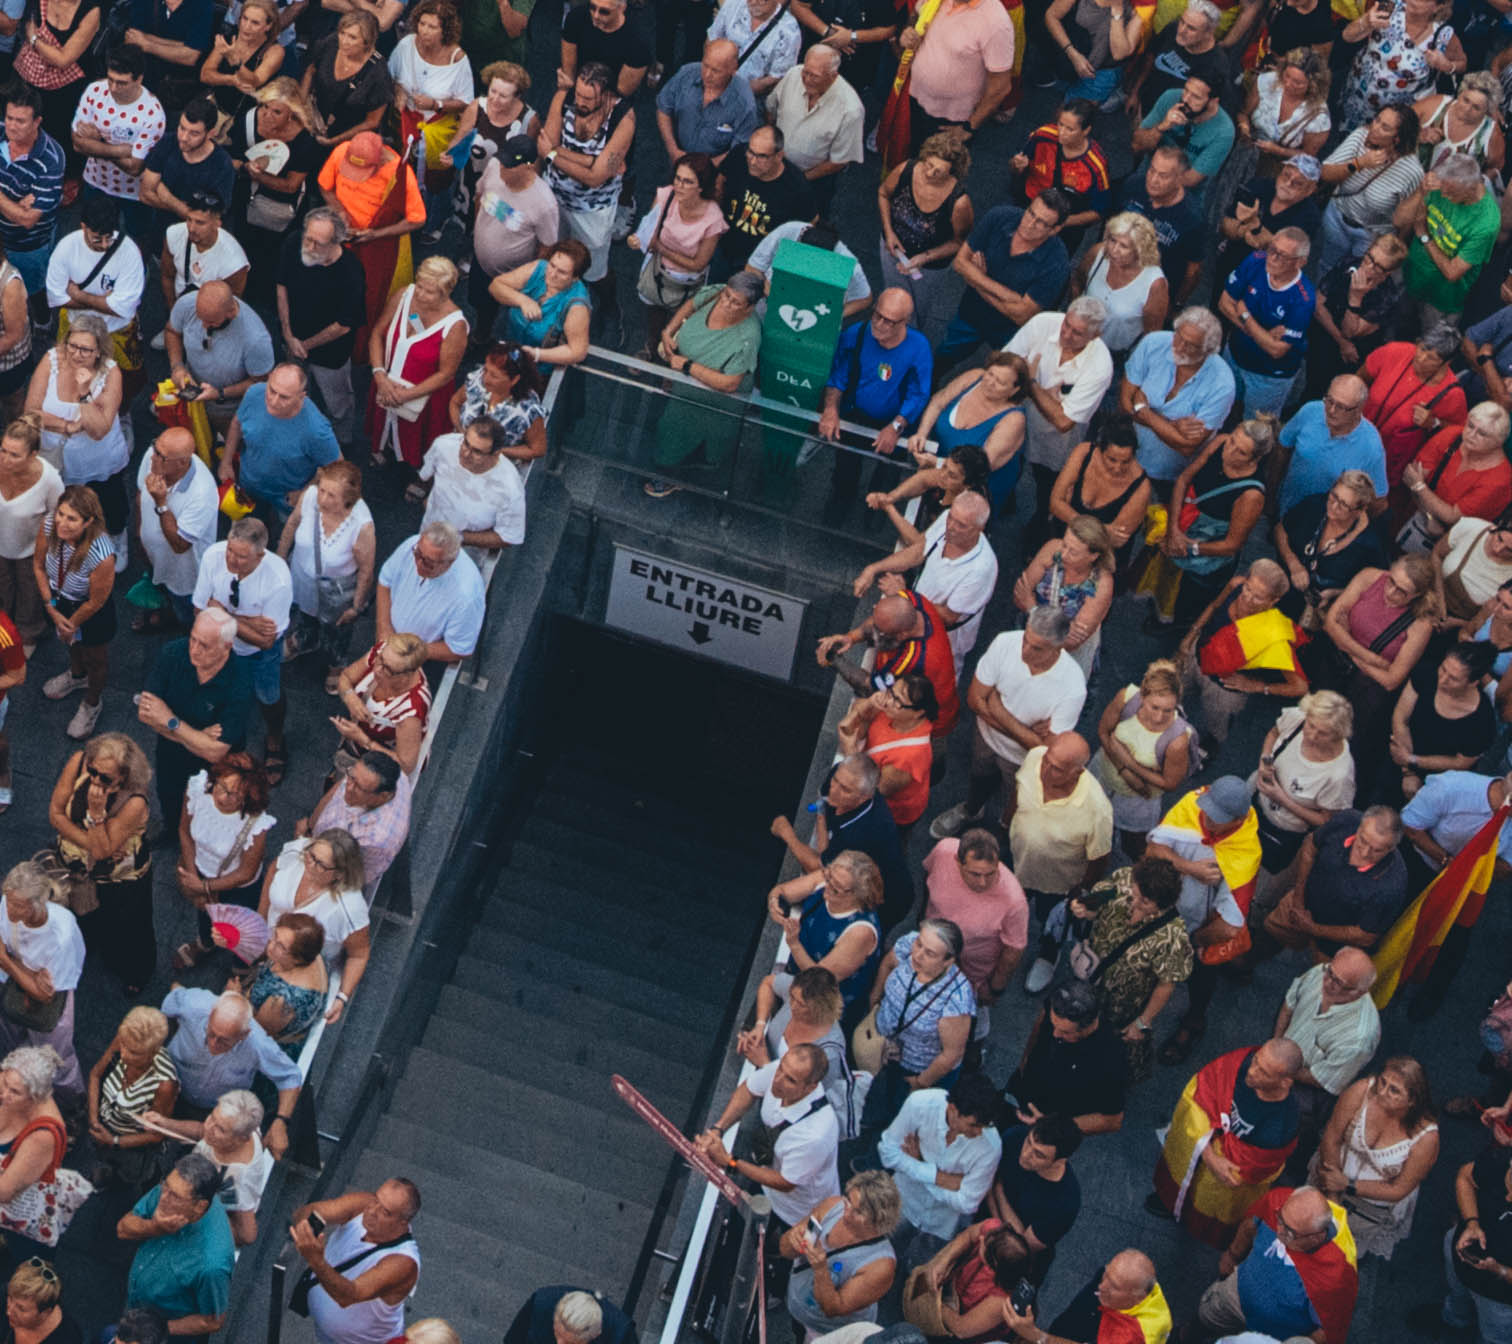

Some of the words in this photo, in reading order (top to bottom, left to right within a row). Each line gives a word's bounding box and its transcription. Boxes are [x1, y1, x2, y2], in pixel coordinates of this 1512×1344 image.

[776, 370, 812, 389] DEA
[629, 558, 785, 624] ENTRADA
[646, 585, 764, 637] LLIURE
